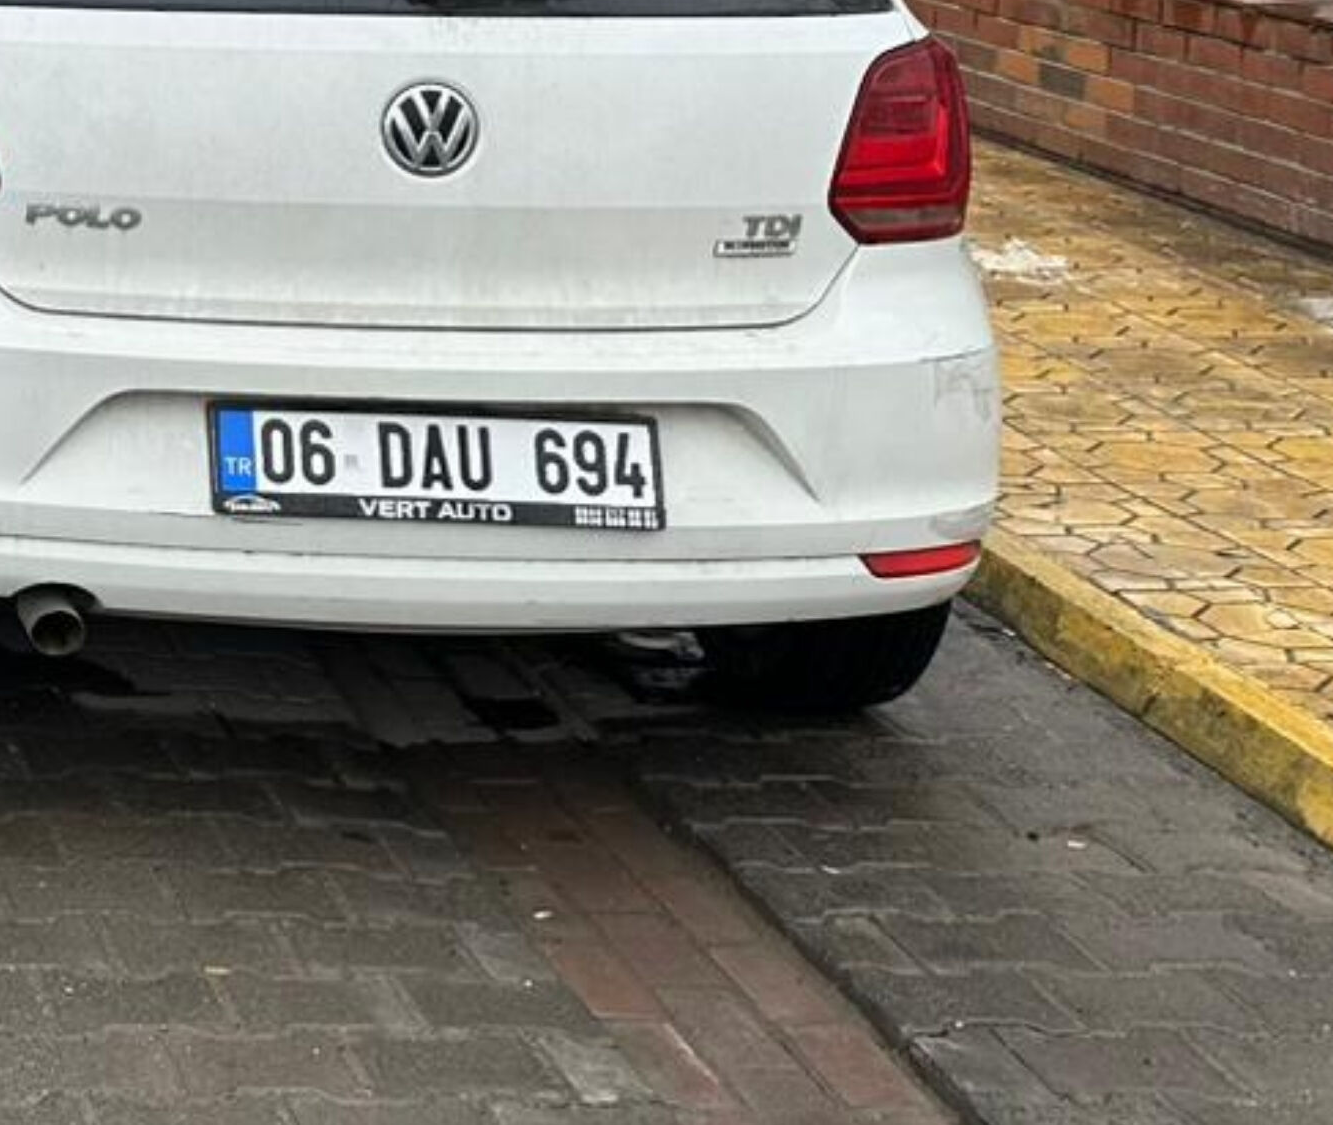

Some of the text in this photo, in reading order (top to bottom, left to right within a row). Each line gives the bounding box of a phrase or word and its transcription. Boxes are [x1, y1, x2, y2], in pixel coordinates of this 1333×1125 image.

[25, 204, 142, 230] POLO
[742, 214, 803, 238] TDI
[224, 456, 253, 476] TR
[260, 418, 647, 499] 06 DAU 694
[358, 497, 515, 522] VERT AUTO
